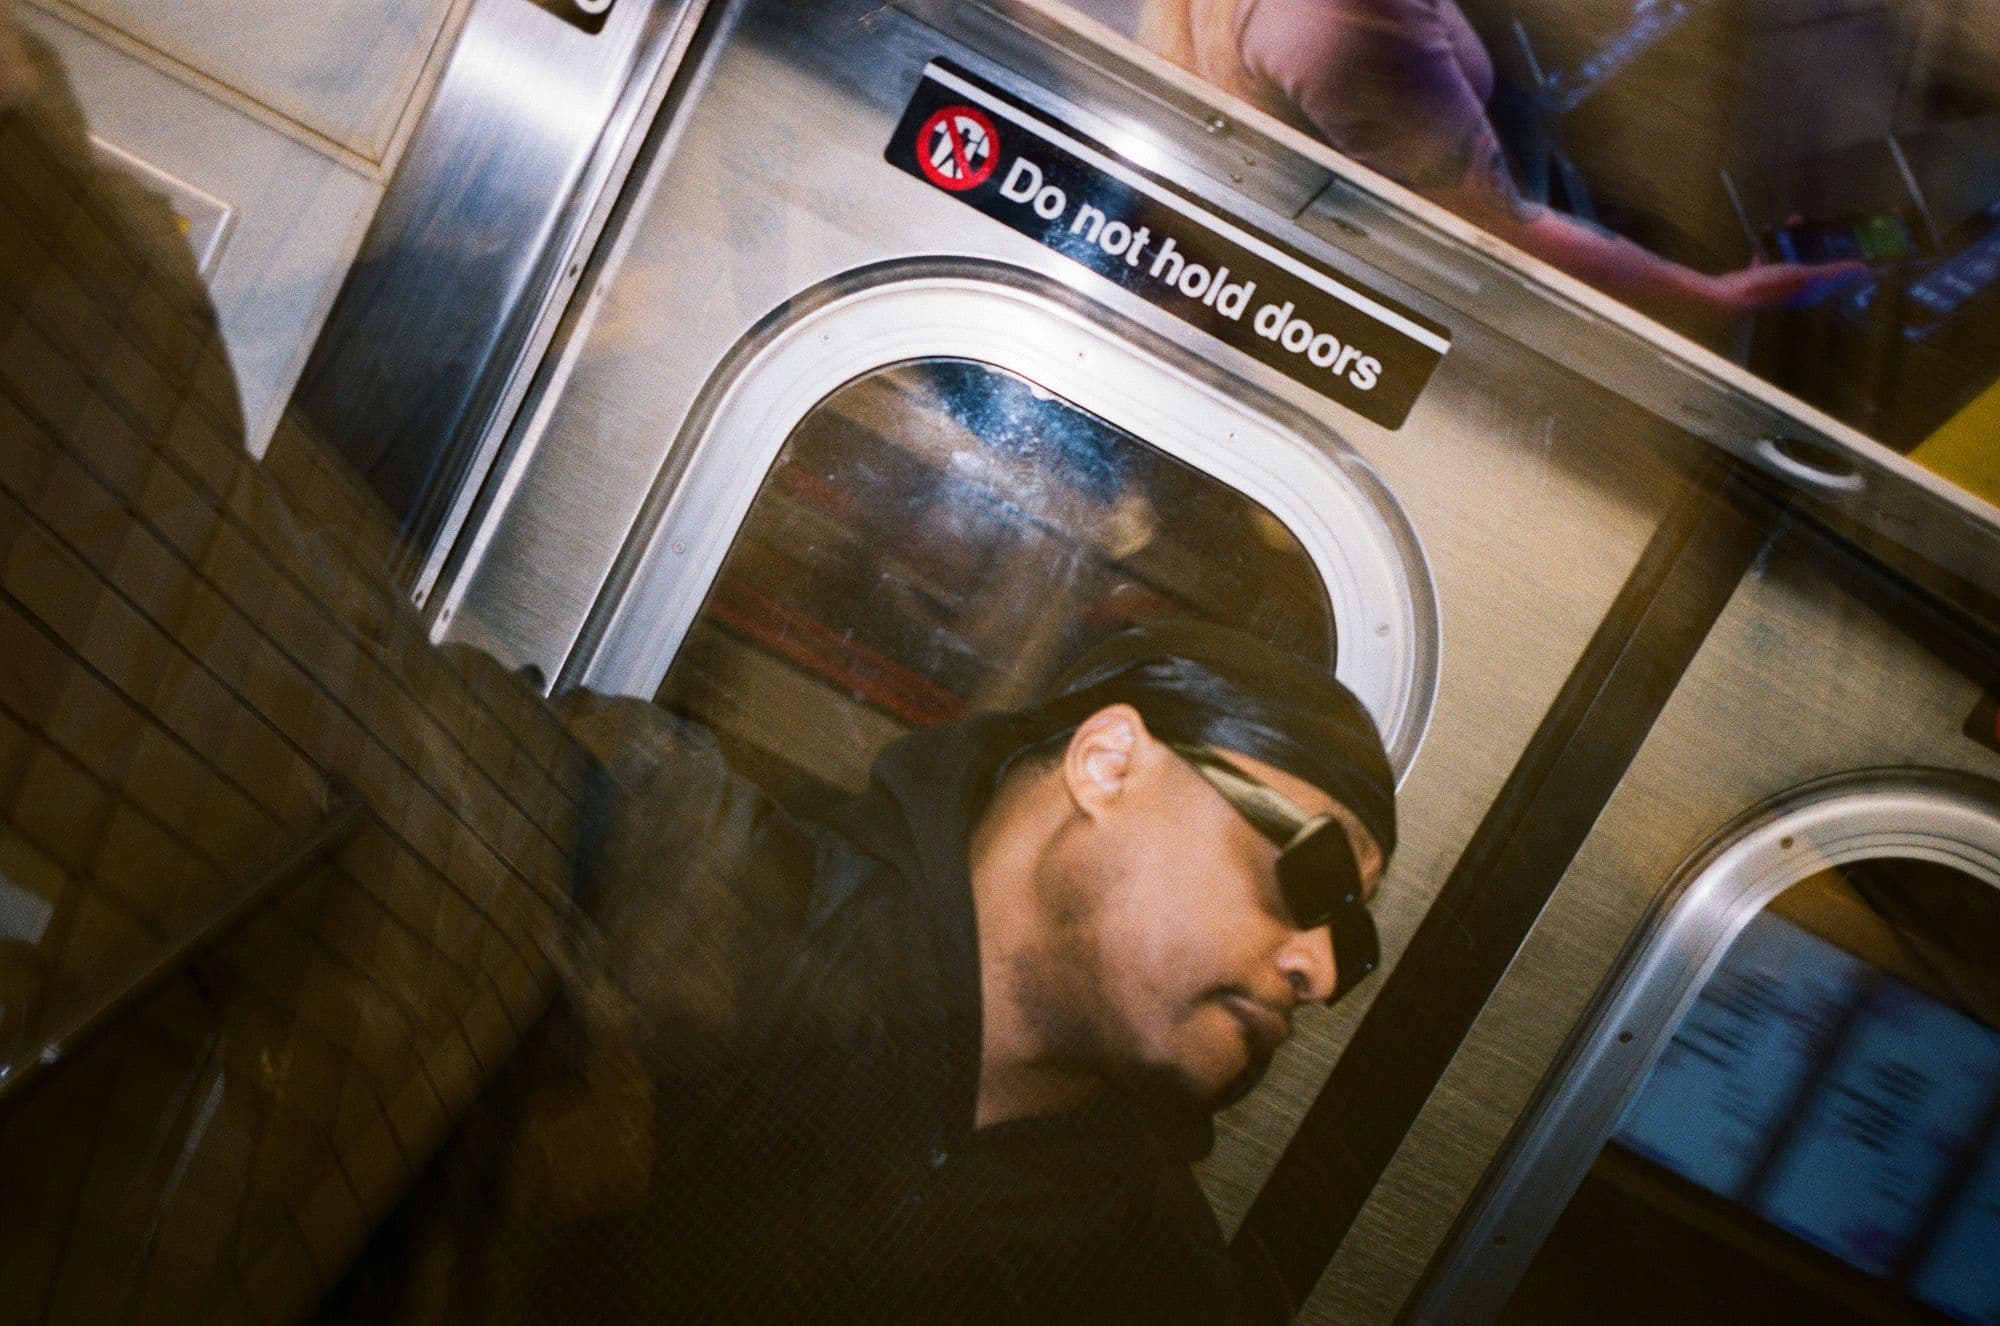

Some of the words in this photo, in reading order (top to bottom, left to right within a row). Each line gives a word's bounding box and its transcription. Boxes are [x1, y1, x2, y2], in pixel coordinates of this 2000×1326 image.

[999, 156, 1066, 219] Do
[1069, 202, 1152, 267] not
[1149, 237, 1255, 321] hold
[1253, 301, 1382, 391] doors
